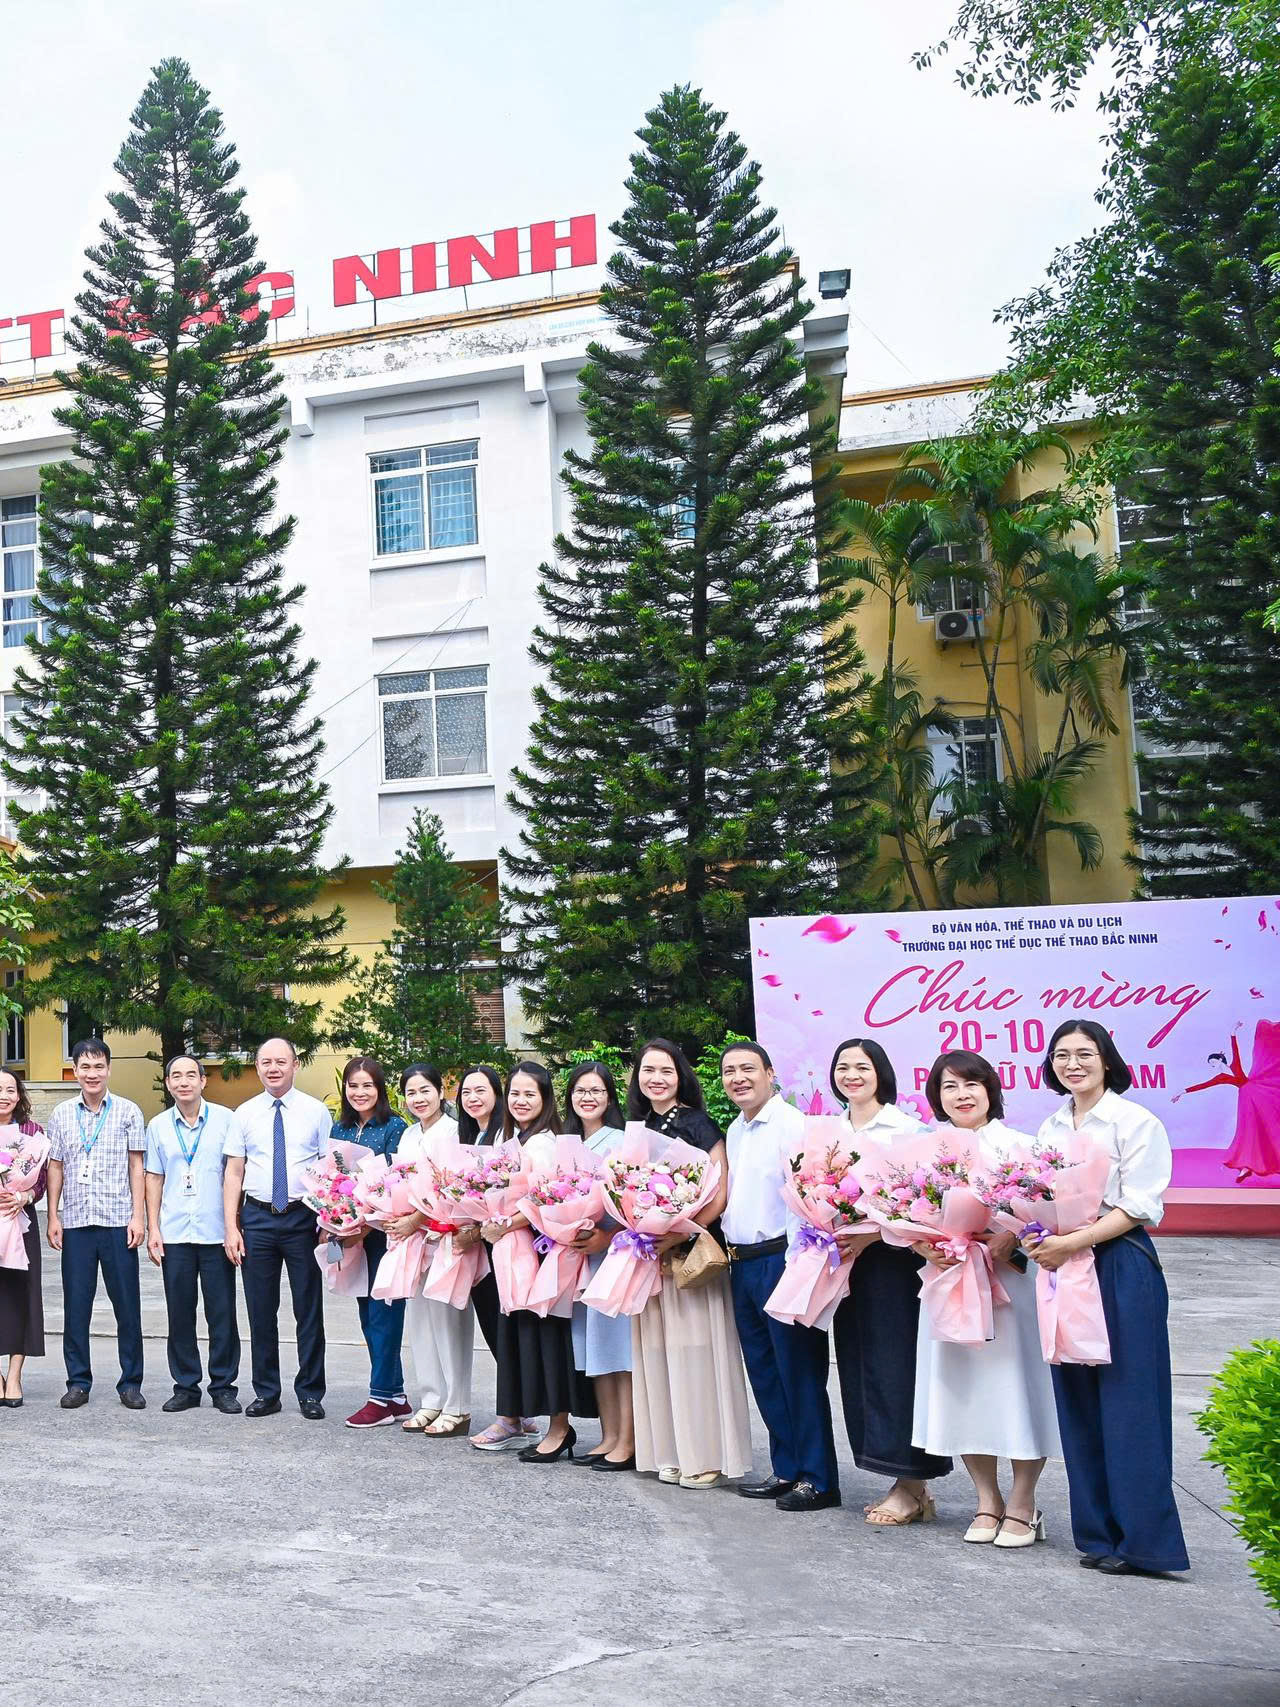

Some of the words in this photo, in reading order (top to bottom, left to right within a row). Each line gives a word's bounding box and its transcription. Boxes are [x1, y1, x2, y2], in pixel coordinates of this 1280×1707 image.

[333, 213, 597, 307] NINH
[902, 939, 945, 952] TRƯỜNG
[948, 941, 967, 953] ĐẠI
[970, 940, 992, 952] HỌC
[995, 934, 1016, 949] THỂ
[1020, 937, 1041, 950] DỤC
[1045, 932, 1066, 948] THỂ
[1069, 935, 1098, 946] THAO
[1102, 931, 1125, 945] BẮC
[1128, 933, 1158, 944] NINH
[932, 922, 947, 935] BỘ
[950, 921, 972, 933] VĂN
[975, 920, 1001, 932] HÓA,
[1004, 917, 1024, 930] THỂ
[1028, 919, 1056, 930] THAO
[1060, 916, 1074, 929] VÀ
[1078, 918, 1093, 928] DU
[1097, 916, 1123, 929] LỊCH
[863, 959, 1024, 1028] Chúc
[1039, 970, 1212, 1049] mừng
[938, 1018, 1045, 1054] 20-10
